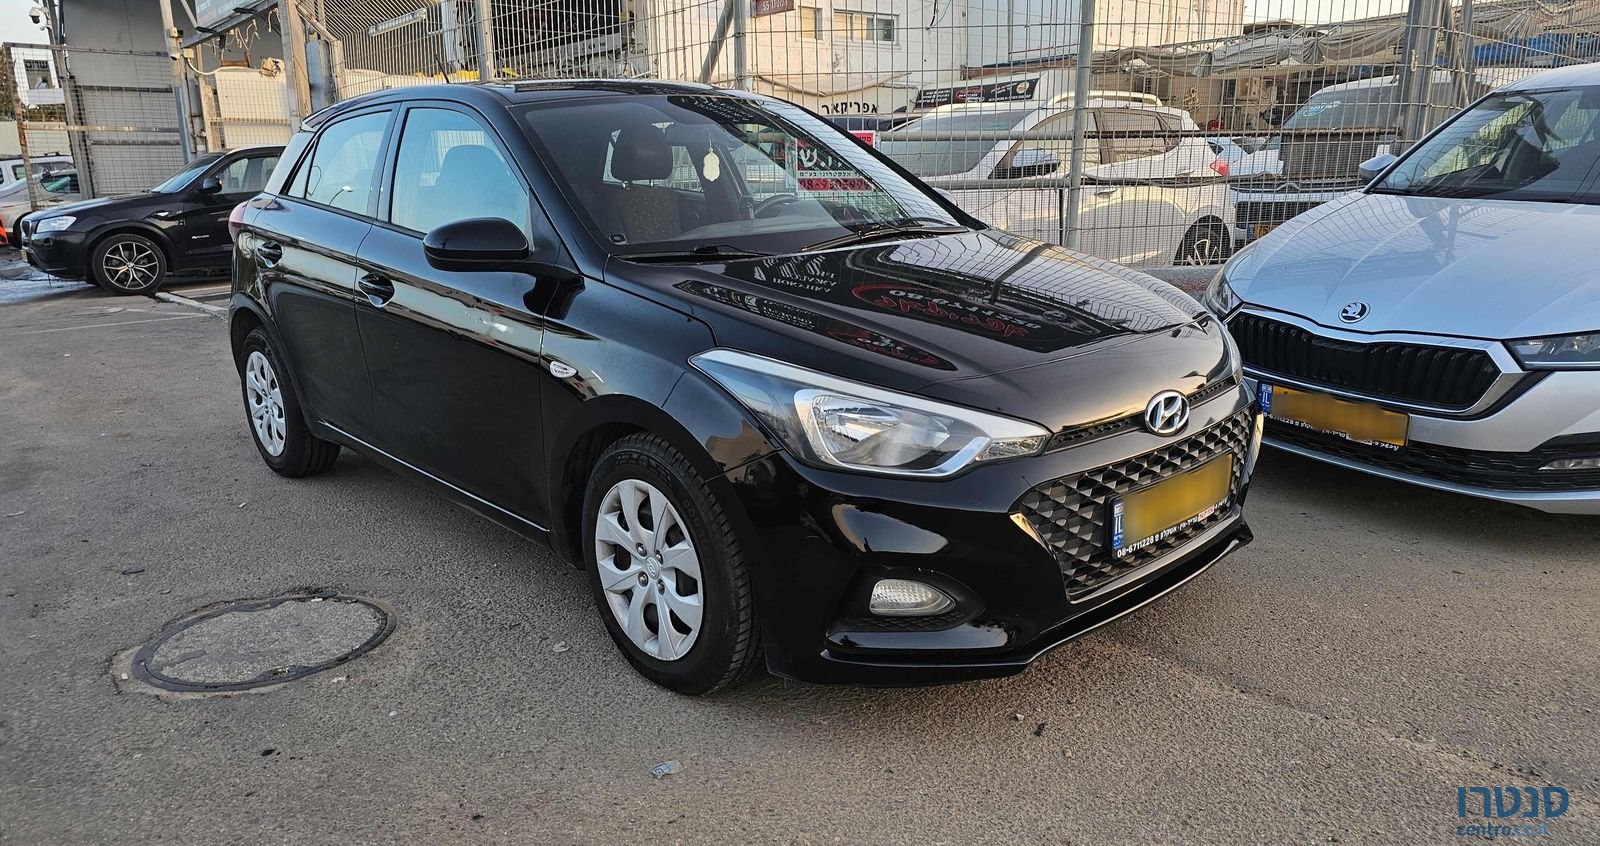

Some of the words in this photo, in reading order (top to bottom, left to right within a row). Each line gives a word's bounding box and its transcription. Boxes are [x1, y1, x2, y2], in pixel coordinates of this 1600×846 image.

[821, 101, 879, 115] אפריקאר
[1262, 391, 1270, 404] IL
[1114, 516, 1123, 534] IL
[1117, 535, 1154, 558] 08-6711228
